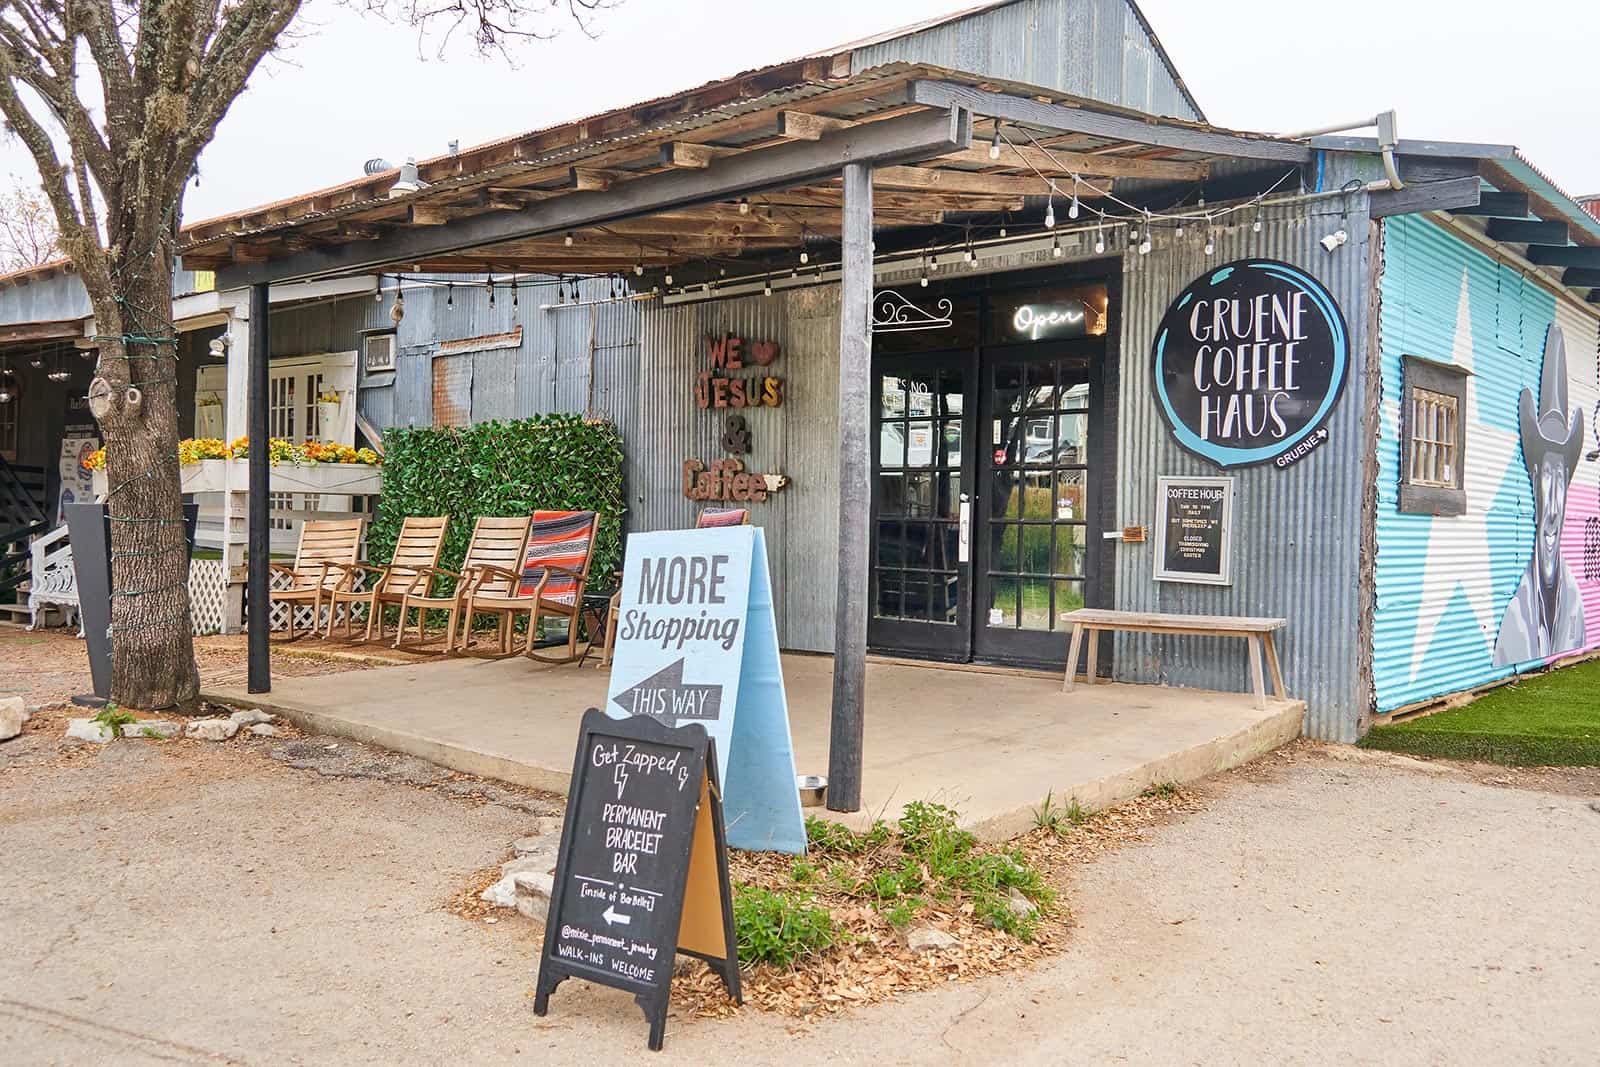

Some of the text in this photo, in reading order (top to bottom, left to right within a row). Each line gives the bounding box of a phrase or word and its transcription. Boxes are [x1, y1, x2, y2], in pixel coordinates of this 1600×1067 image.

[1013, 305, 1084, 341] Open
[1190, 290, 1308, 343] GRUENE
[705, 334, 743, 369] WE
[1194, 342, 1300, 392] COFFEE
[694, 370, 781, 409] JESUS
[1200, 391, 1291, 441] HAUS
[723, 415, 752, 454] &
[1276, 434, 1320, 467] GRUENE
[683, 458, 769, 502] Coffee
[1168, 488, 1199, 499] COFFEE
[638, 555, 729, 605] MORE
[620, 609, 740, 651] Shopping
[632, 688, 709, 715] THIS WAY
[593, 744, 680, 775] Get Zapped
[603, 803, 667, 831] PERMANENT
[605, 827, 663, 854] BRACELET
[613, 852, 637, 875] BAR
[608, 890, 617, 902] of
[559, 944, 655, 981] WALK-INS WELCOME
